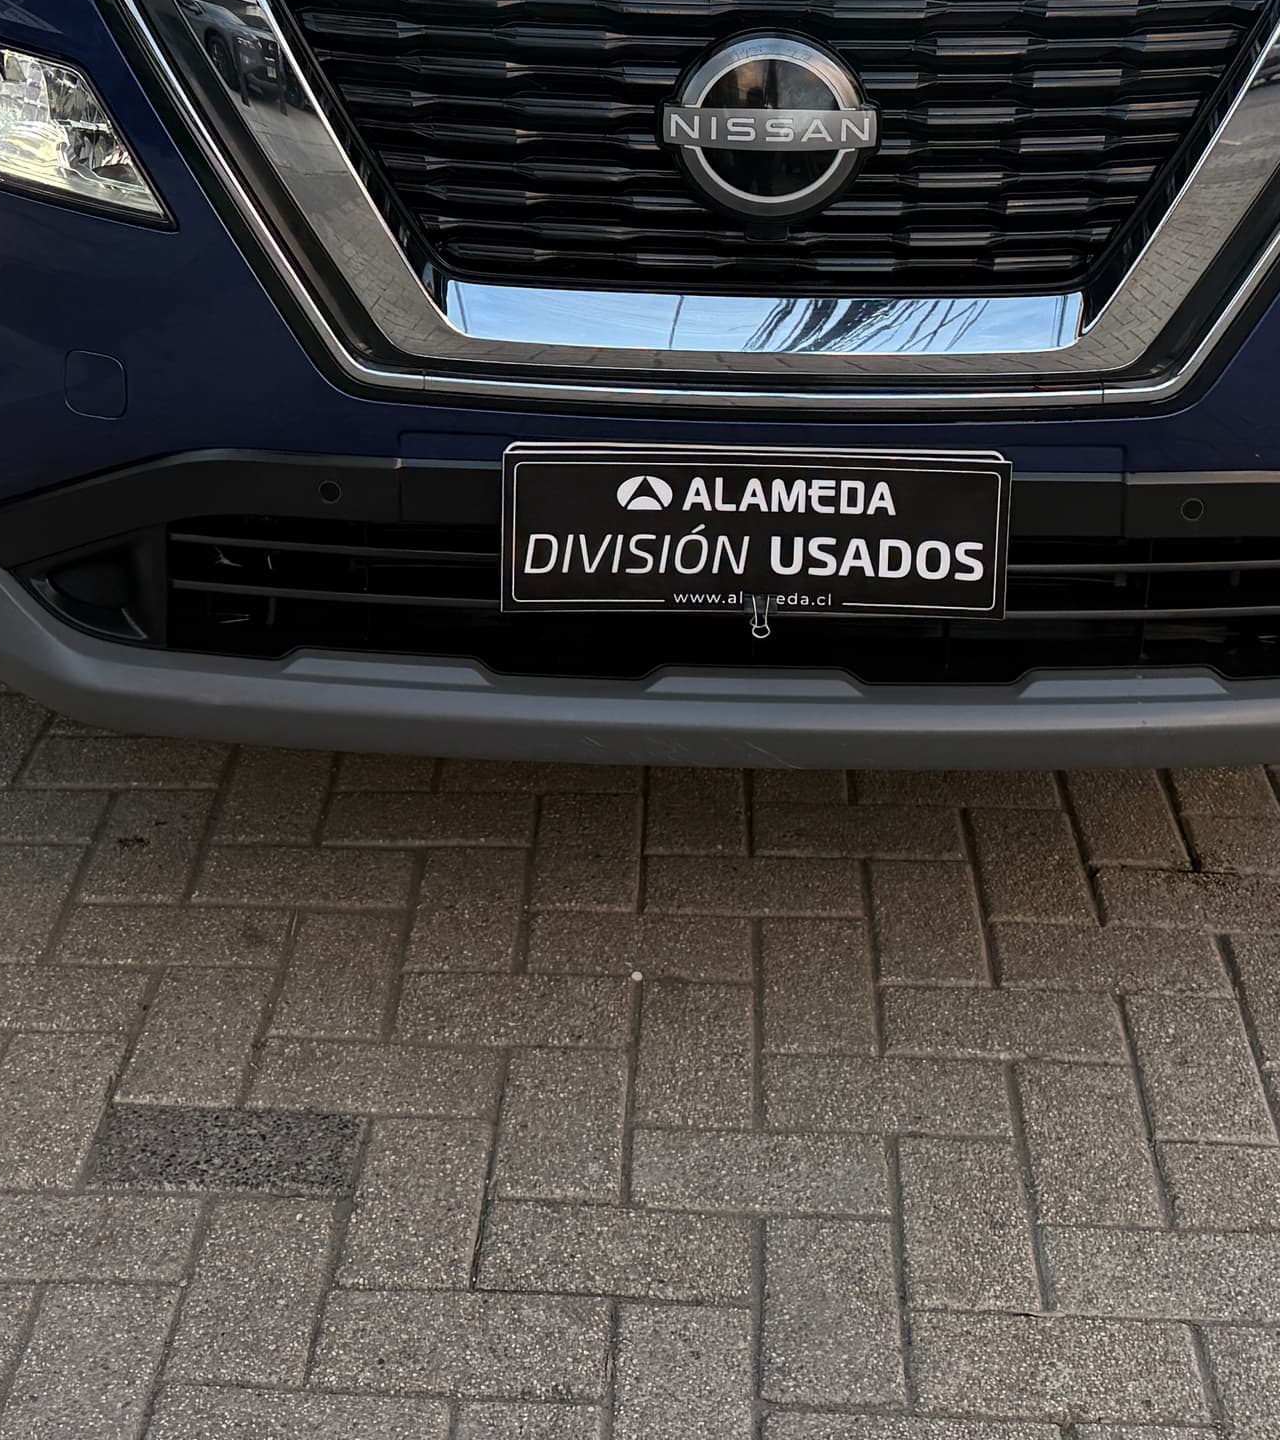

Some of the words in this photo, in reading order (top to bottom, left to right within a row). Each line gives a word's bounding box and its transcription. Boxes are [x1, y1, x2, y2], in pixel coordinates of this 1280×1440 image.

[670, 113, 870, 143] NISSAN
[681, 476, 897, 516] ALAMEDA
[523, 523, 750, 575] DIVISIÓN
[769, 535, 985, 581] USADOS
[673, 590, 832, 607] www.aleda.cl
